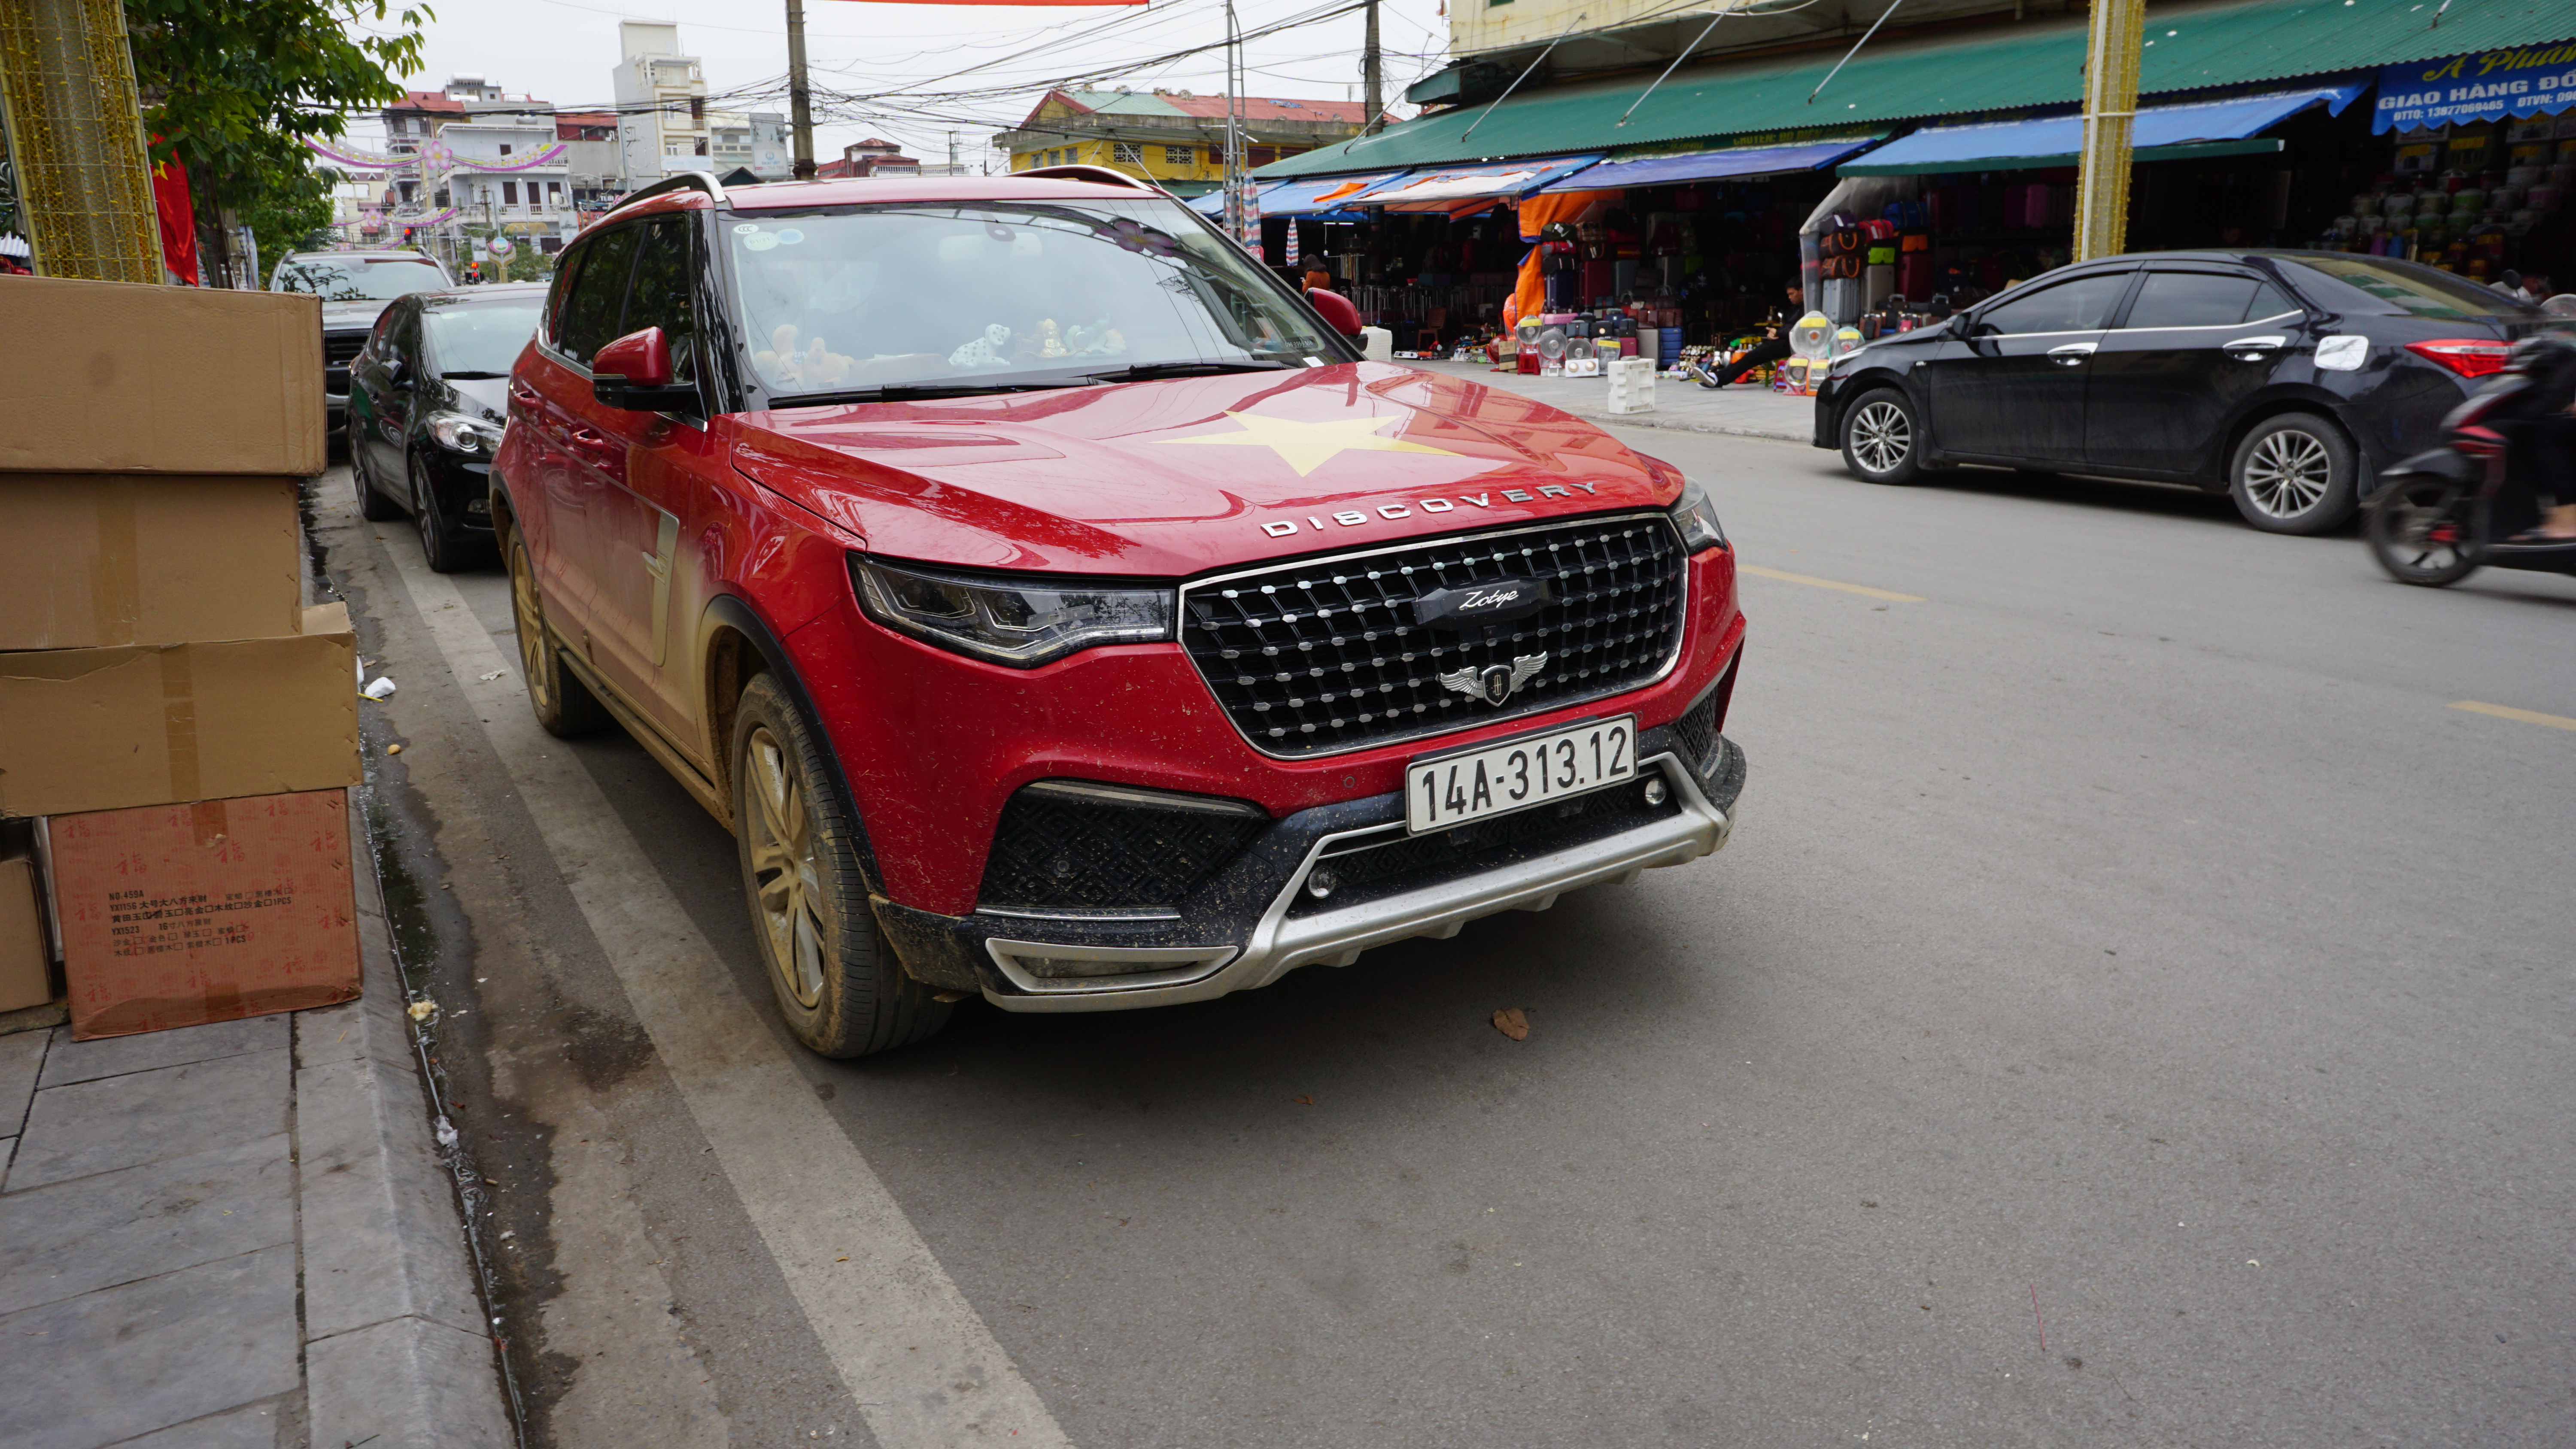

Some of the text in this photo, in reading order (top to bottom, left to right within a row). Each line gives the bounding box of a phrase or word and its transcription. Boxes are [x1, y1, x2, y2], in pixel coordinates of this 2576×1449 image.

[2422, 55, 2469, 82] A
[2378, 91, 2441, 110] GIAO
[2449, 82, 2529, 102] HÀNG
[1260, 482, 1596, 538] DISCOVERY
[1458, 590, 1519, 611] Zotye
[1422, 726, 1628, 822] 14A-313.12
[110, 902, 137, 912] YX1156
[274, 897, 292, 905] 1PCS
[112, 926, 140, 935] YX1523
